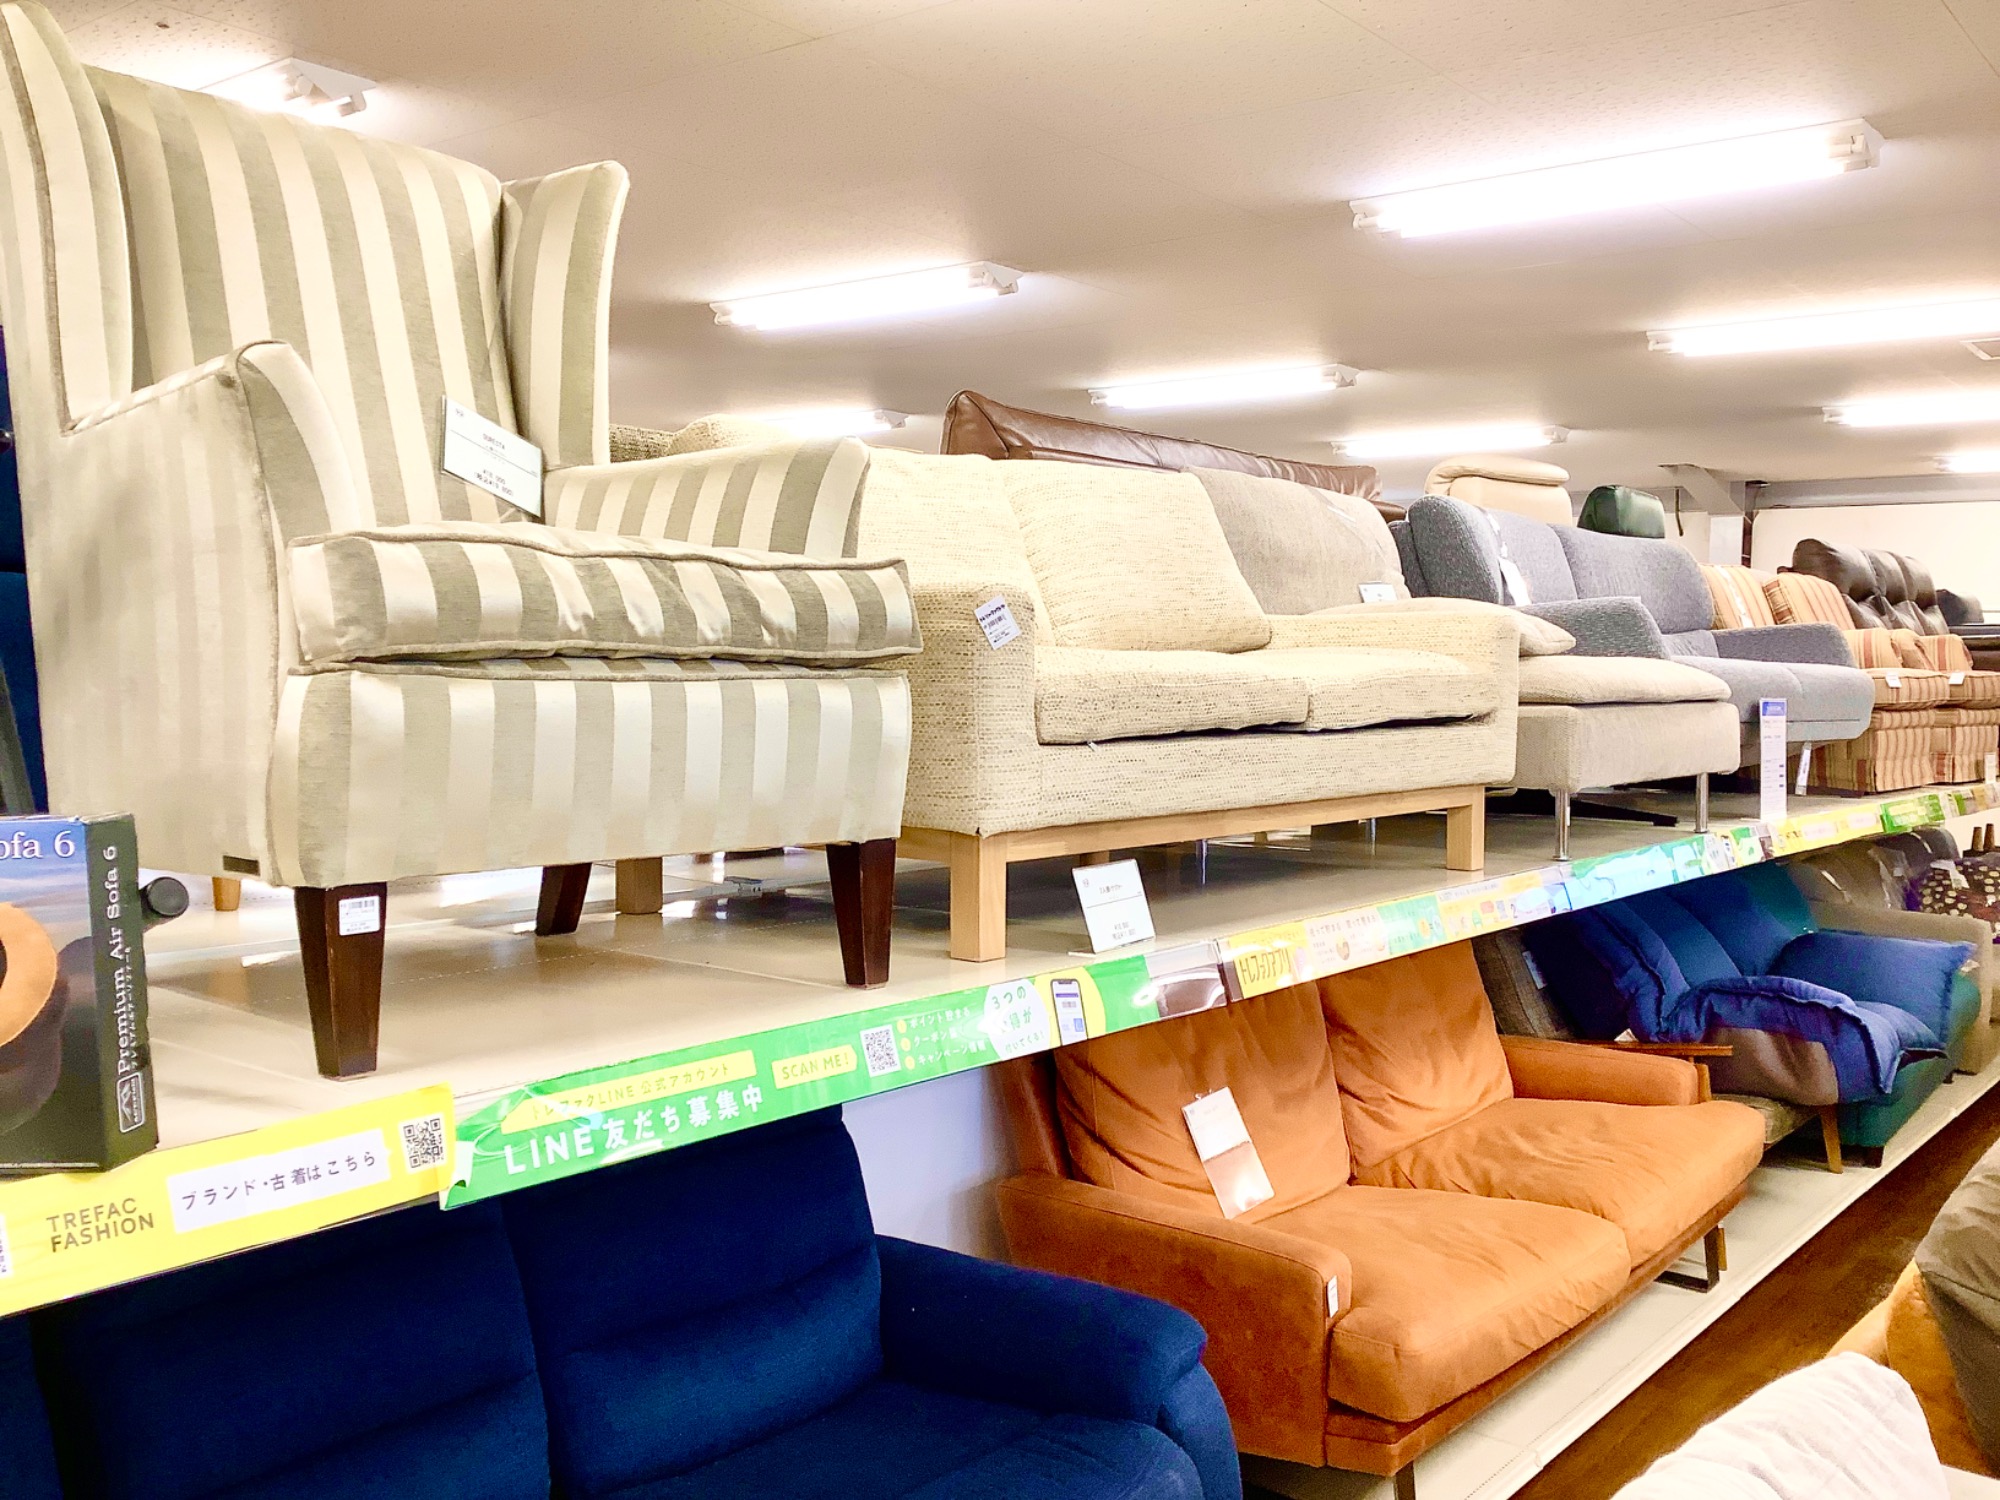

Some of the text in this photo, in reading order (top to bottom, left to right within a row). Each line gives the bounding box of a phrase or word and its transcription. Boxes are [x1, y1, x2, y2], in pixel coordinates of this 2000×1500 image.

[54, 830, 75, 858] 6
[103, 846, 131, 1075] Premium Air Sofa 6
[992, 986, 1027, 1010] 3つの
[1000, 1006, 1032, 1032] 得が
[782, 1059, 819, 1080] SCAN
[182, 1151, 375, 1210] ブランド・古着はこちら
[46, 1198, 137, 1233] TREFAC
[51, 1213, 154, 1253] FASHION
